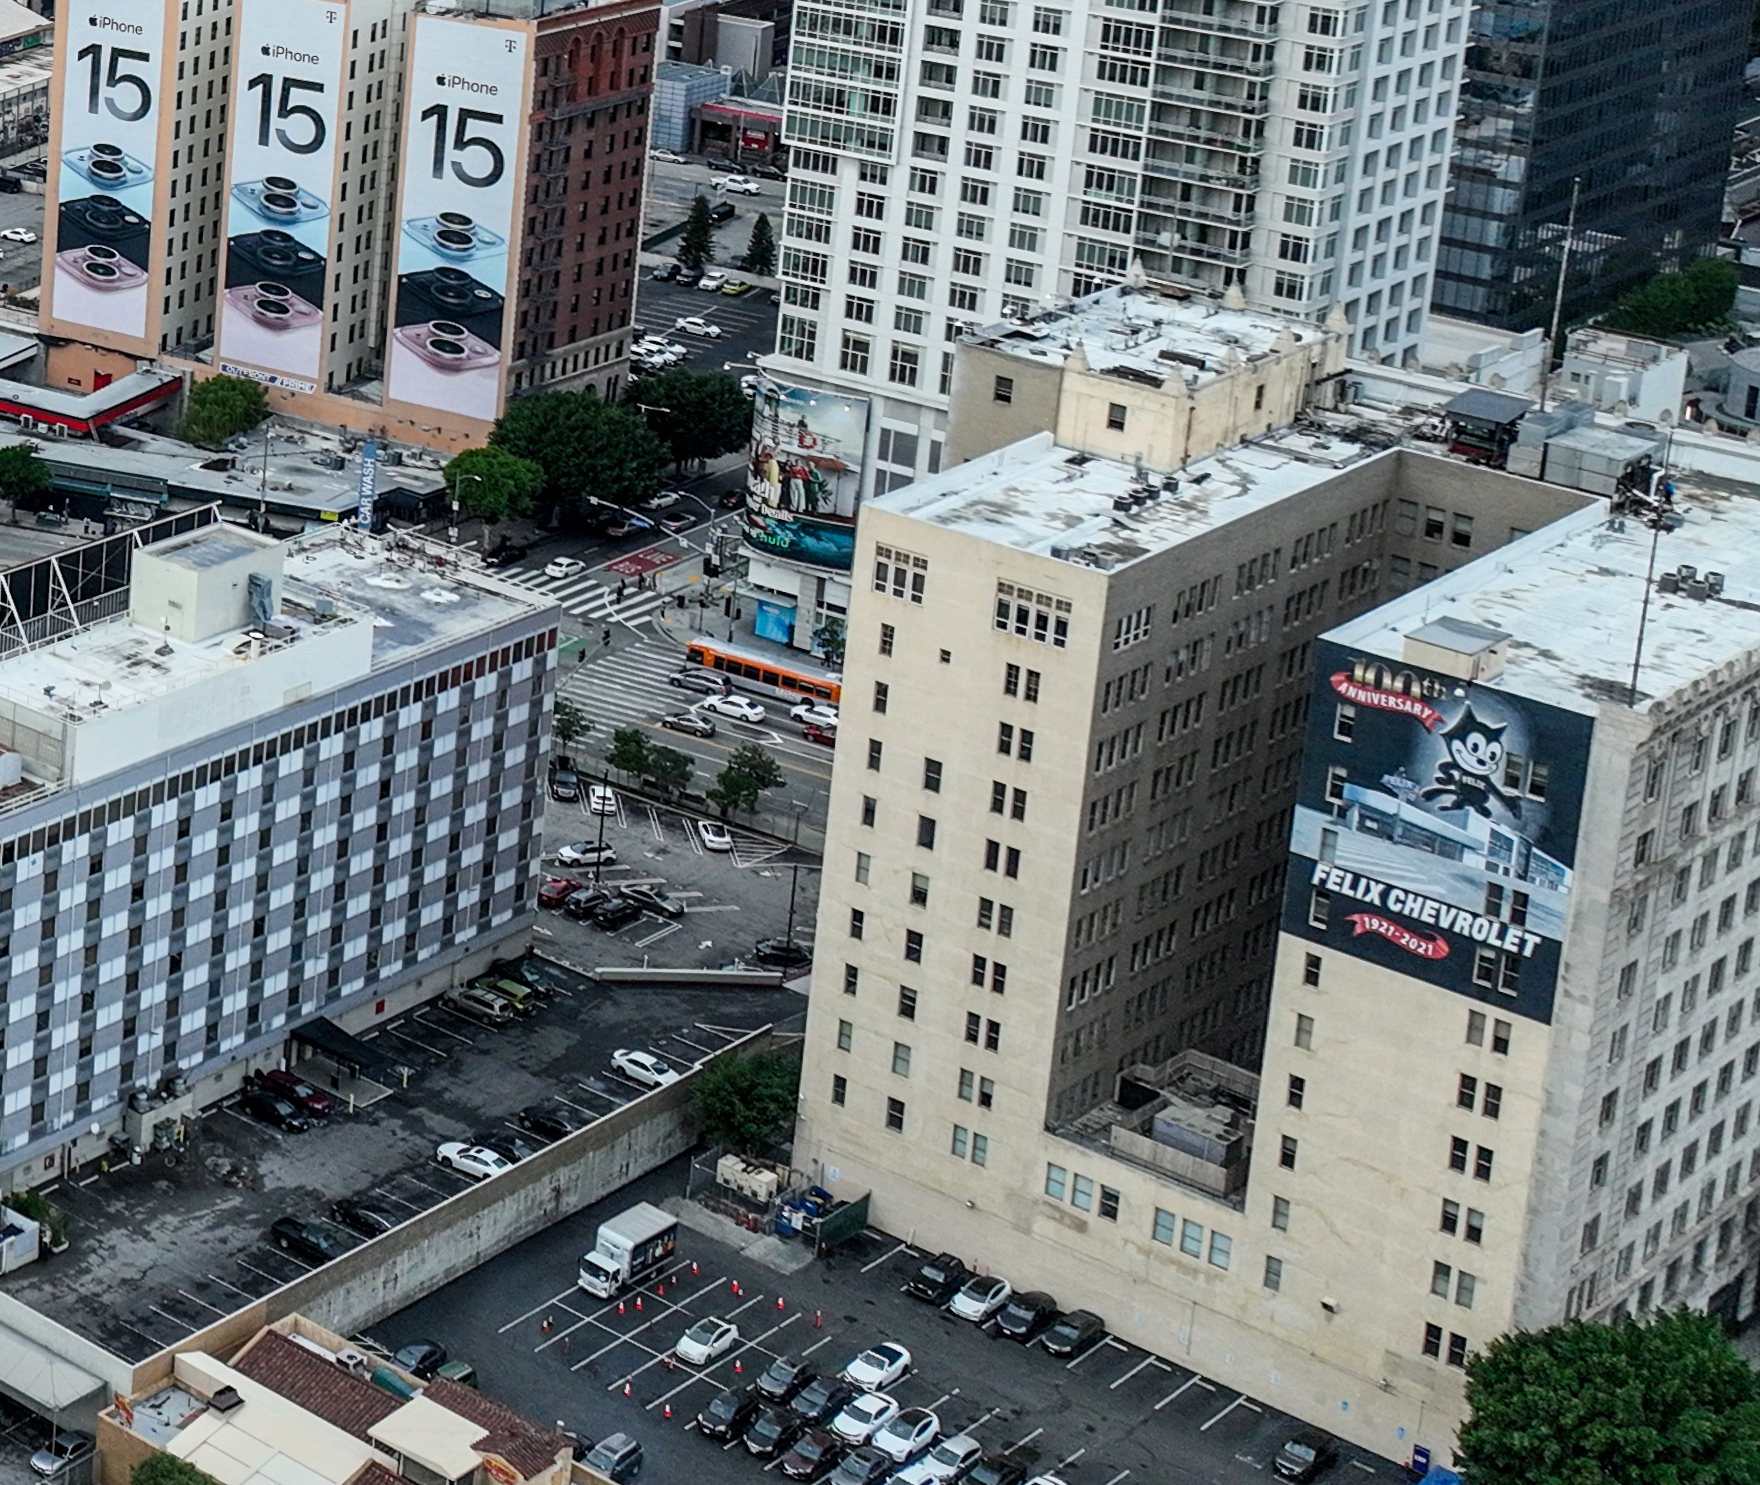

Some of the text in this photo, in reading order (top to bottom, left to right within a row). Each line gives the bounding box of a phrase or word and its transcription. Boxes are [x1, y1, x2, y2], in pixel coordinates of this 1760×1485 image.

[99, 15, 143, 36] iPhone
[271, 45, 320, 66] iPhone
[77, 44, 152, 122] 15
[447, 74, 498, 98] iPhone
[247, 73, 327, 155] 15
[420, 104, 506, 189] 15
[1349, 657, 1448, 702] 100th
[1338, 682, 1433, 719] ANNIVERSARY
[1462, 776, 1487, 789] FELIX
[1311, 862, 1542, 959] FELIX CHEVROLET
[1362, 916, 1434, 957] 1921-2021
